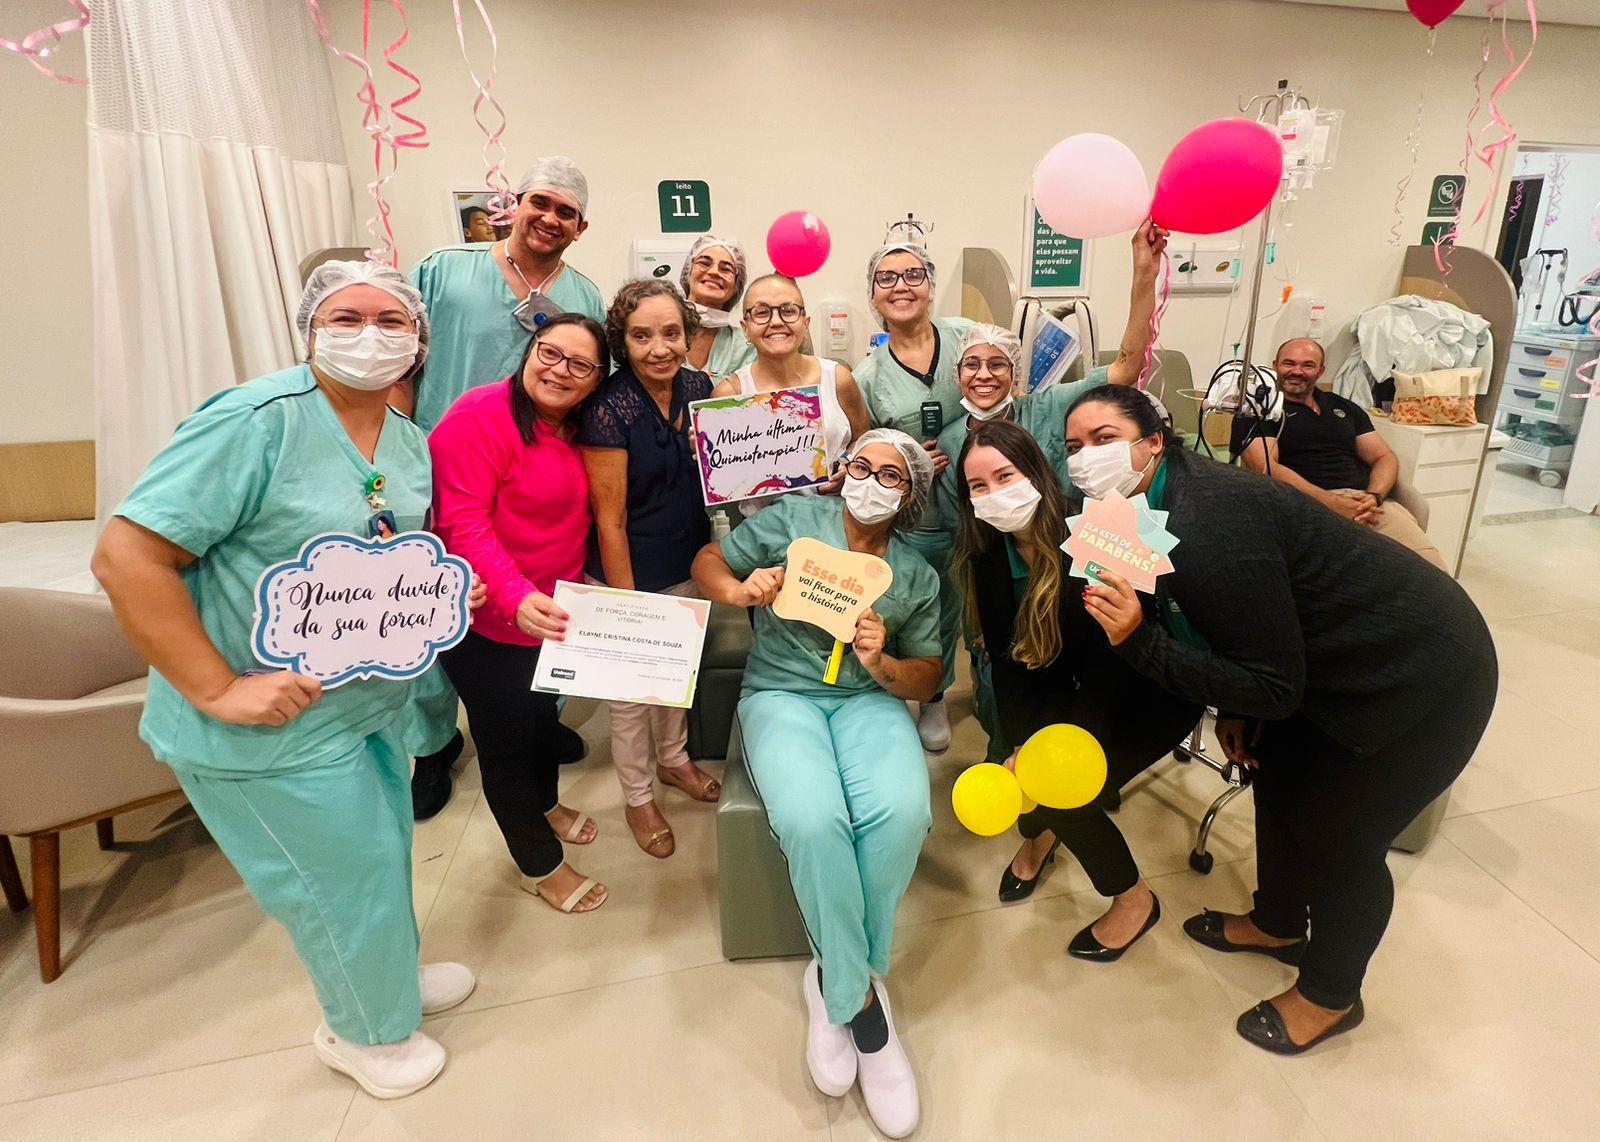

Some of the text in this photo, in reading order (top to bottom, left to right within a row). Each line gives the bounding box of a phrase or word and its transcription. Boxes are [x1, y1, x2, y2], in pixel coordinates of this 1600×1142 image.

[676, 182, 692, 190] leito
[671, 195, 700, 216] 11
[1035, 258, 1072, 267] aproveitar
[717, 419, 805, 446] Minha última
[710, 434, 815, 468] Quimioterapia!!!
[1084, 522, 1133, 548] ELA ESTÁ DE
[1078, 530, 1156, 573] PARABÉNS!
[287, 572, 450, 610] Nunca duvide
[799, 576, 858, 606] vai ficar para
[802, 559, 864, 596] Esse dia
[808, 592, 847, 614] história!
[293, 607, 436, 640] da sua força!
[579, 630, 602, 638] ELAYNE
[603, 633, 631, 642] CRISTINA
[632, 637, 652, 645] COSTA
